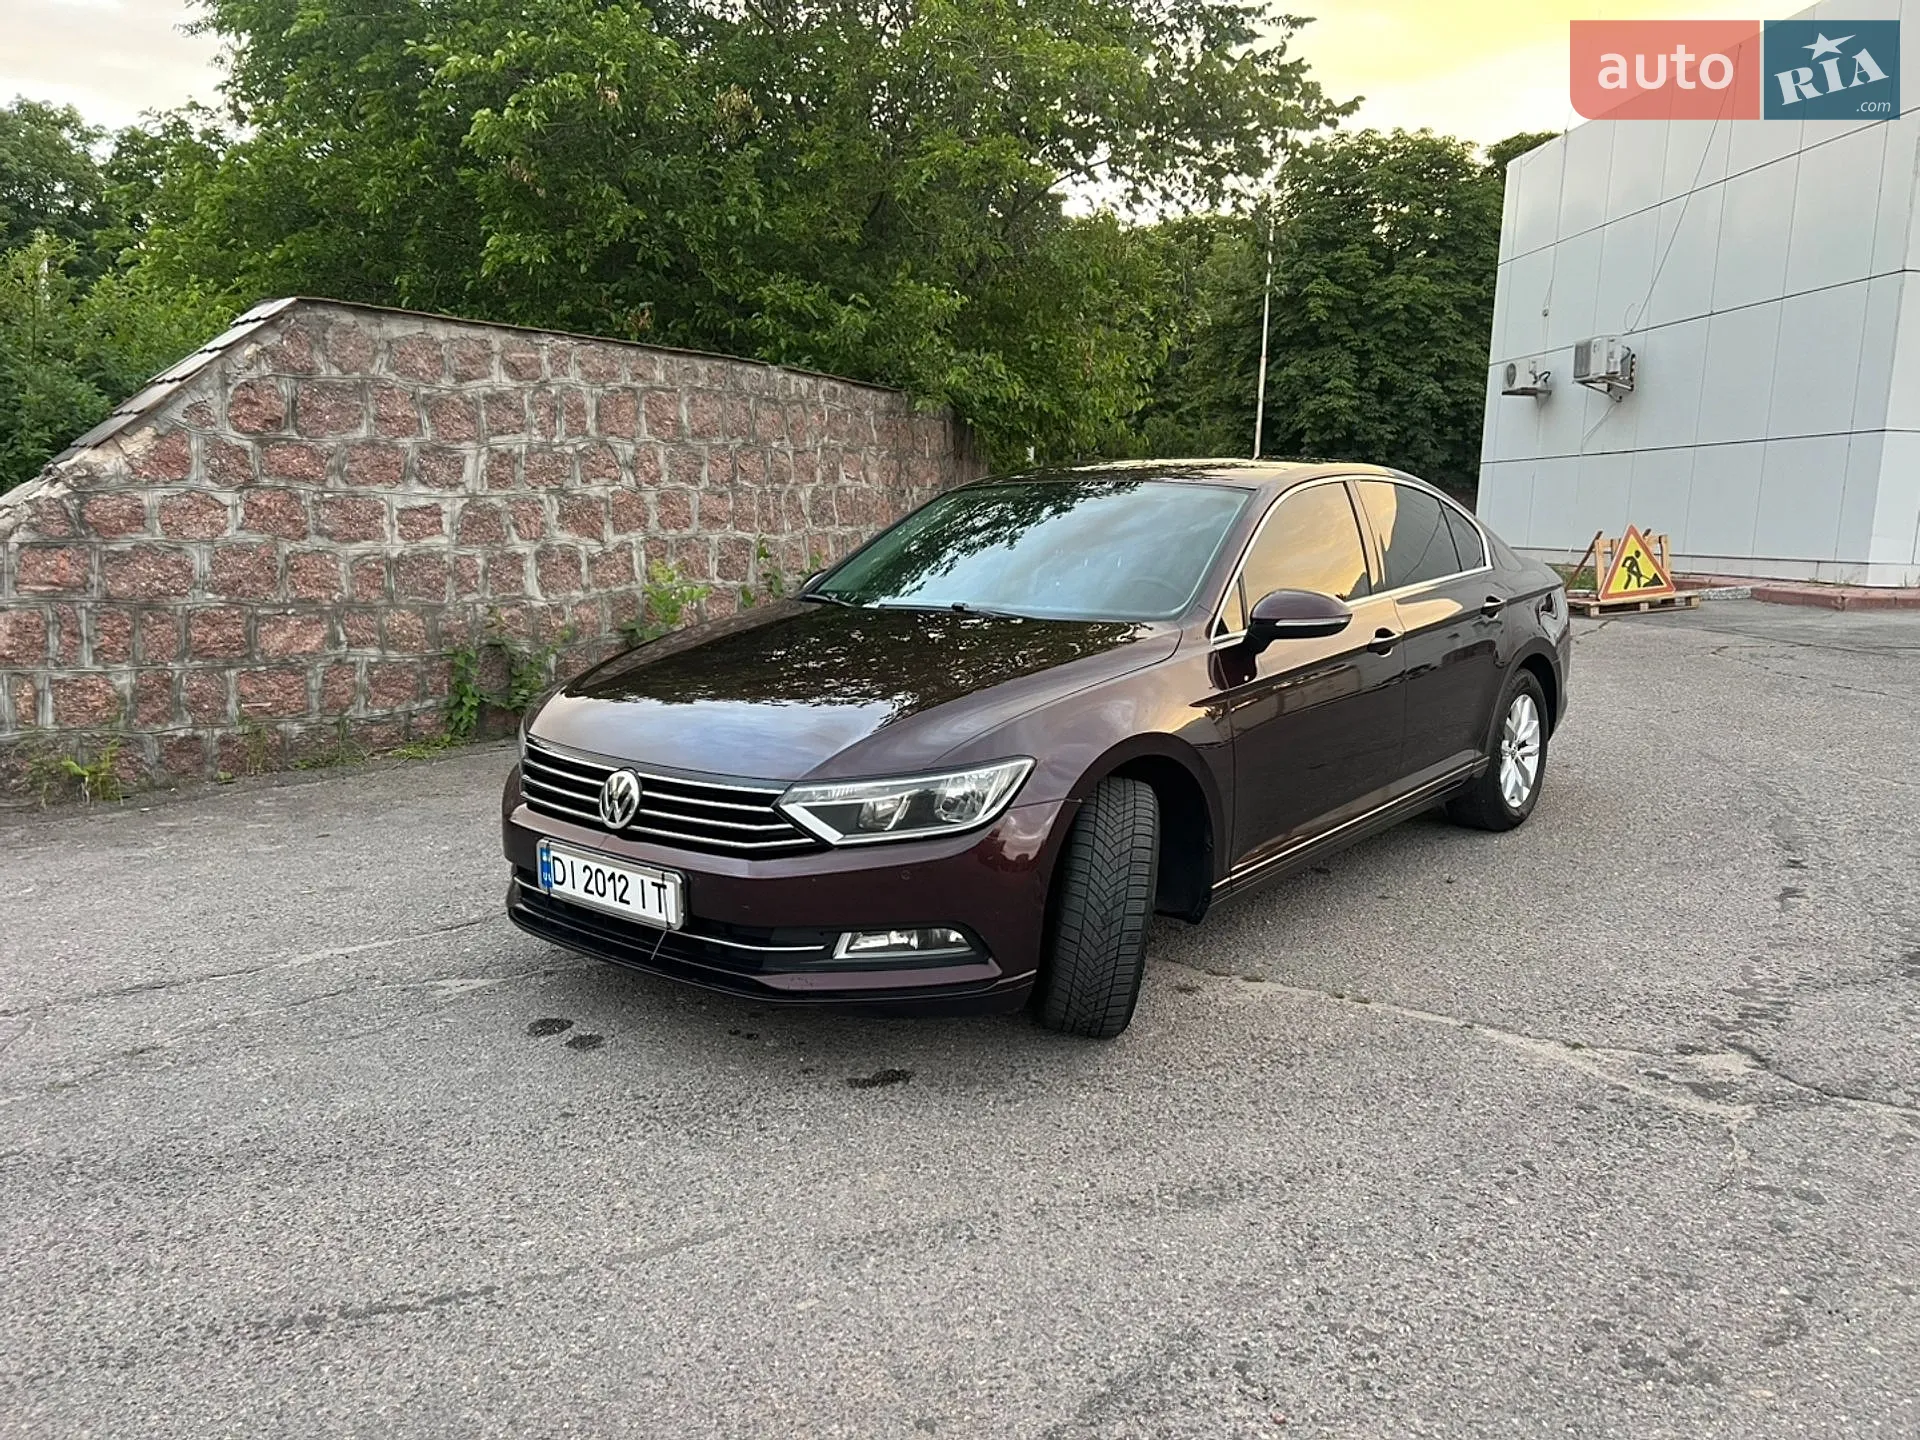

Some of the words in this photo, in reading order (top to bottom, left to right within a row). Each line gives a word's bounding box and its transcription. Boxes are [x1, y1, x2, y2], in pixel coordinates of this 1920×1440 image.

[552, 855, 576, 890] DI
[582, 864, 631, 906] 2012
[640, 878, 668, 914] IT
